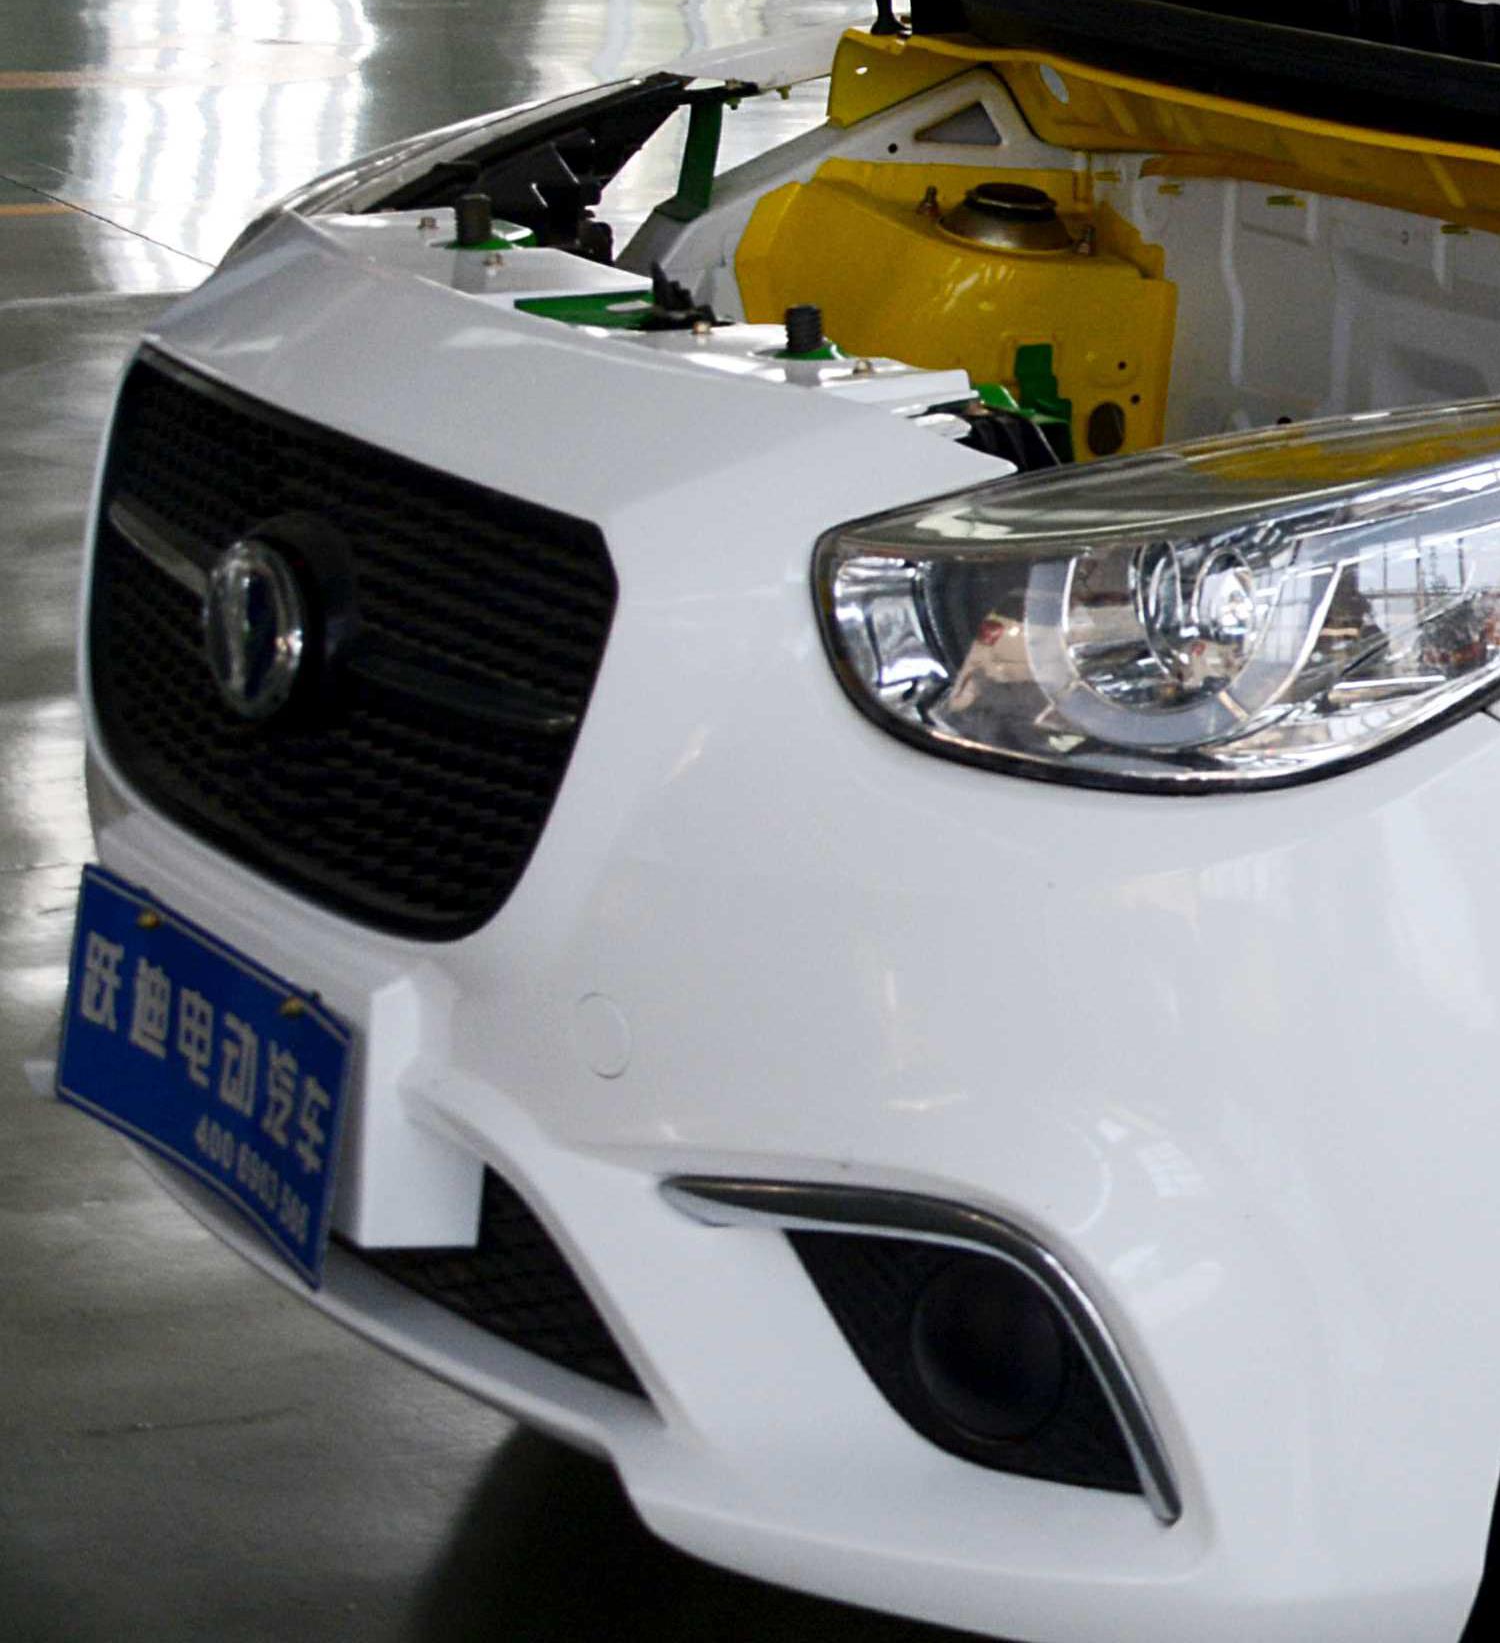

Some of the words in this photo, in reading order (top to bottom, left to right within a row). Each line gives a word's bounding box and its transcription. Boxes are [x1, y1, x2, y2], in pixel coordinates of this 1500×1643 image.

[79, 929, 332, 1174] 跃迪电动汽车
